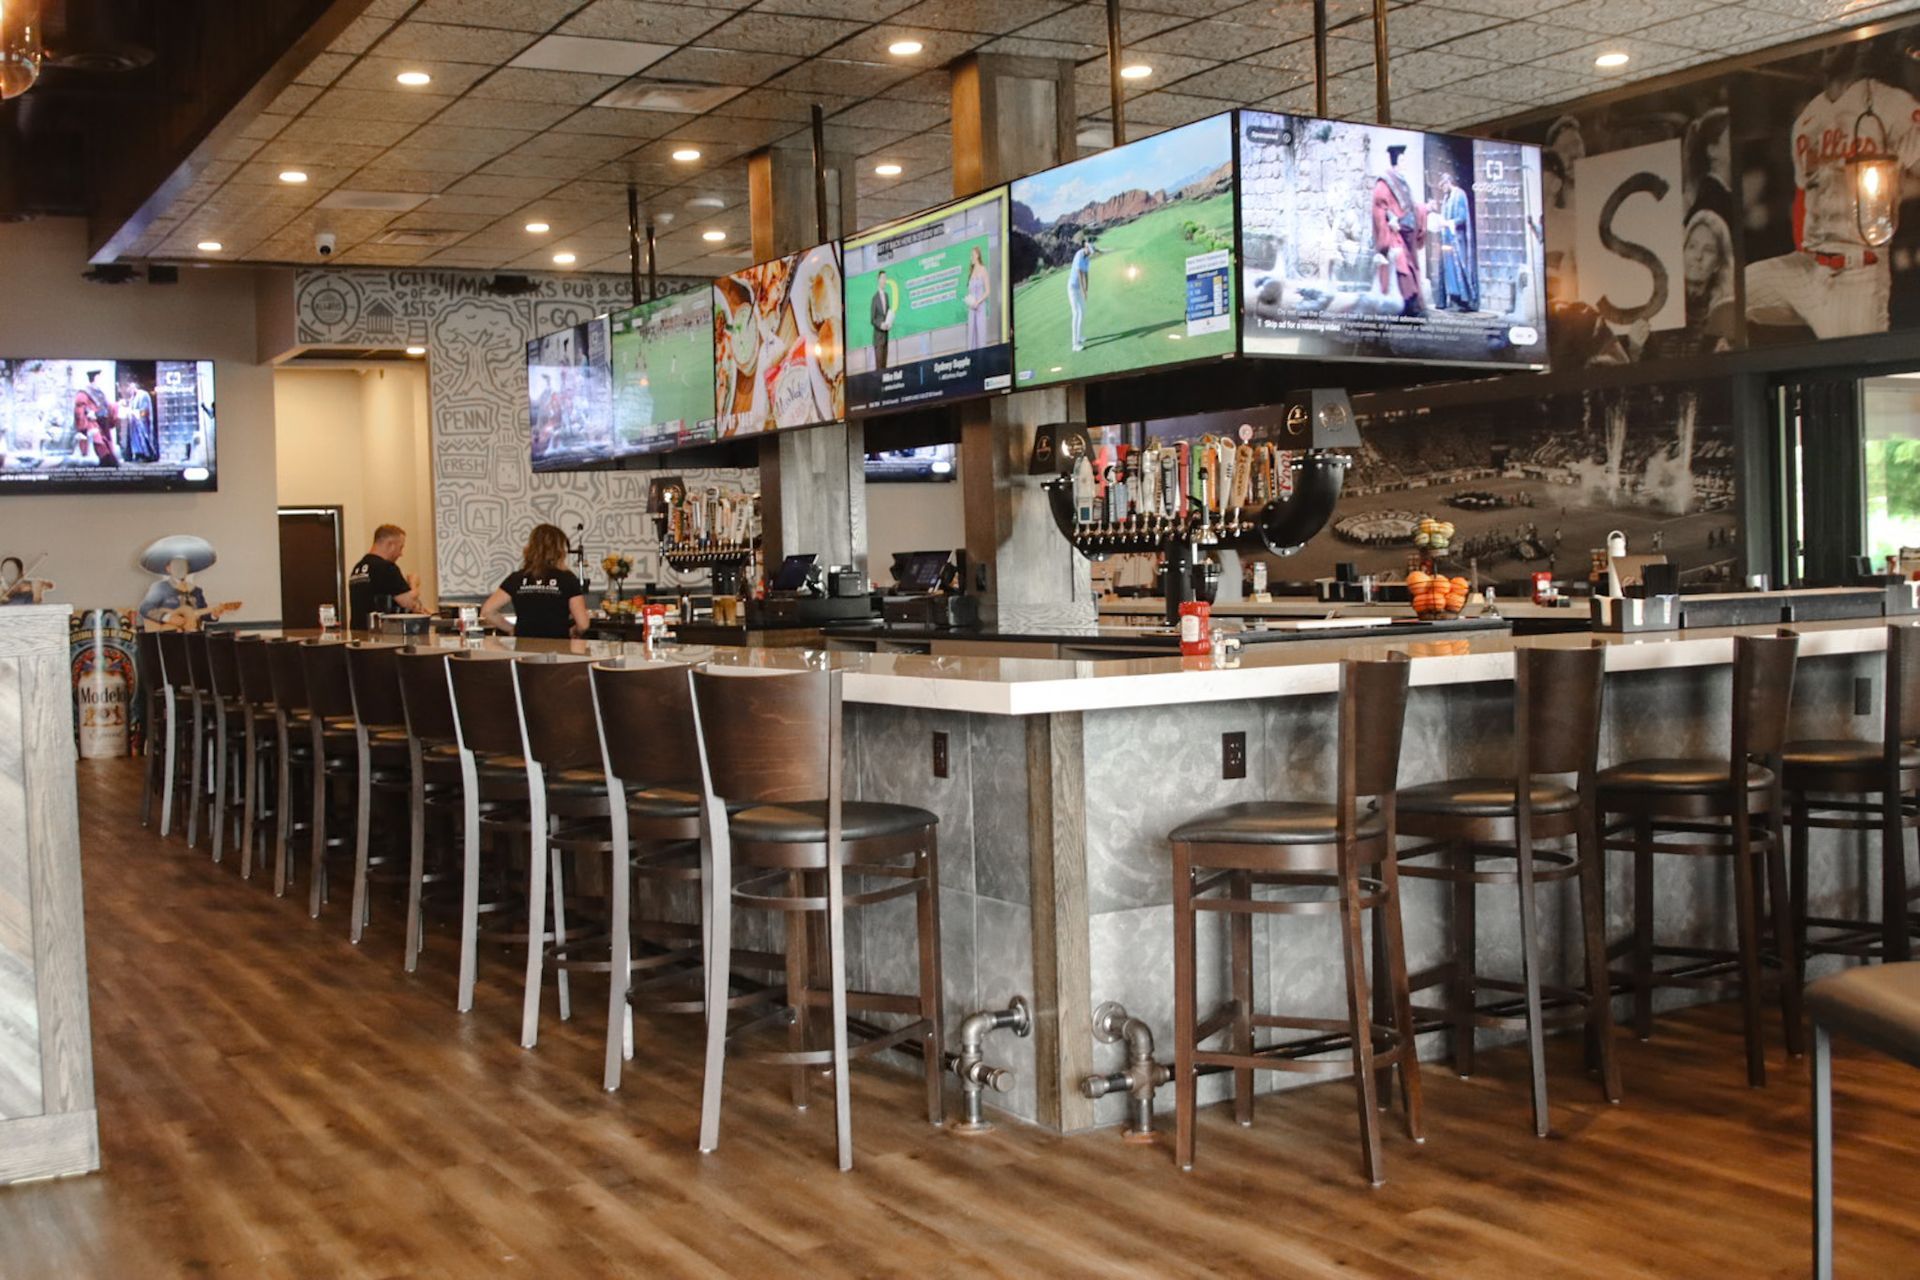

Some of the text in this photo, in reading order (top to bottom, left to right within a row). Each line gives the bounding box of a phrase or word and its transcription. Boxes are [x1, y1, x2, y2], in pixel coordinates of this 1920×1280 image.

[1796, 128, 1878, 162] Pllies
[1598, 171, 1670, 325] S
[456, 275, 557, 298] MAKS
[562, 281, 594, 298] PUB
[598, 281, 611, 297] &
[550, 308, 579, 328] GO
[441, 409, 488, 430] PENN
[443, 457, 485, 472] FRESH
[612, 474, 650, 500] JAW
[636, 555, 654, 580] 1
